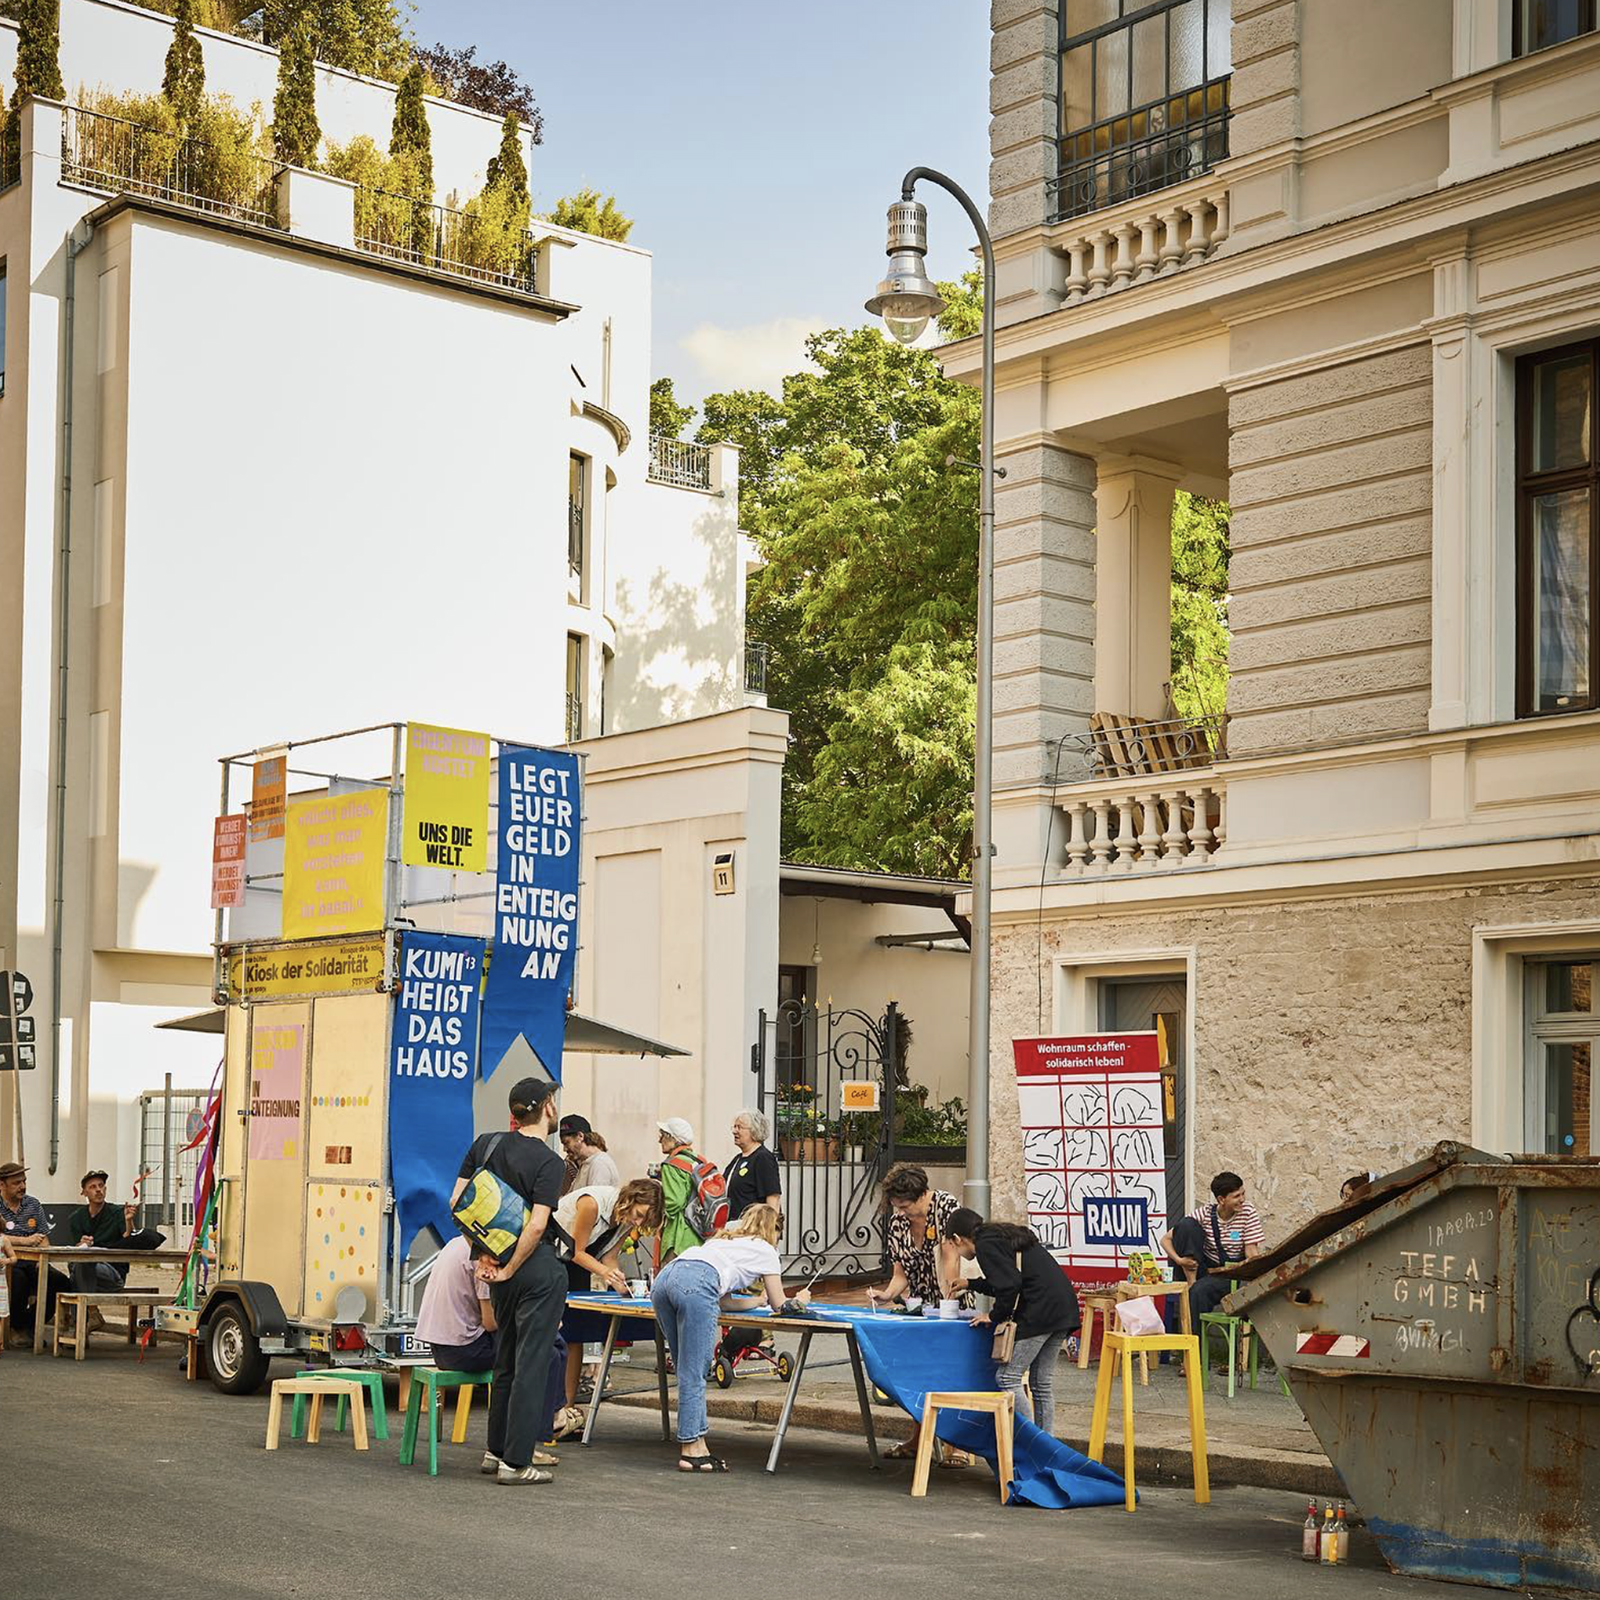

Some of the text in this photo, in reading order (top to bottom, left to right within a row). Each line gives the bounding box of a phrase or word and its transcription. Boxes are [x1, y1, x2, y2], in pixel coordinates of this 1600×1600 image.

[509, 762, 571, 797] LEGT
[510, 792, 573, 828] EUER
[419, 821, 473, 847] UNS DIE
[505, 823, 572, 858] GELD
[426, 843, 465, 867] WELT.
[510, 853, 535, 884] IN
[718, 872, 728, 886] 11
[497, 882, 578, 922] ENTEIG
[501, 915, 570, 952] NUNG
[246, 962, 279, 983] Kiosk
[281, 961, 303, 980] der
[305, 954, 369, 978] Solidarität
[520, 951, 562, 980] AN
[408, 1014, 462, 1046] DAS
[1037, 1043, 1086, 1054] Wohnraum
[1087, 1040, 1126, 1052] schaffen
[396, 1046, 469, 1080] HAUS
[1045, 1057, 1094, 1069] solidarisch
[252, 1080, 261, 1098] IN
[251, 1099, 300, 1119] ENTEIGNUNG
[1086, 1203, 1143, 1238] RAUM
[1400, 1250, 1480, 1282] TEFA
[1394, 1278, 1486, 1314] GMBH
